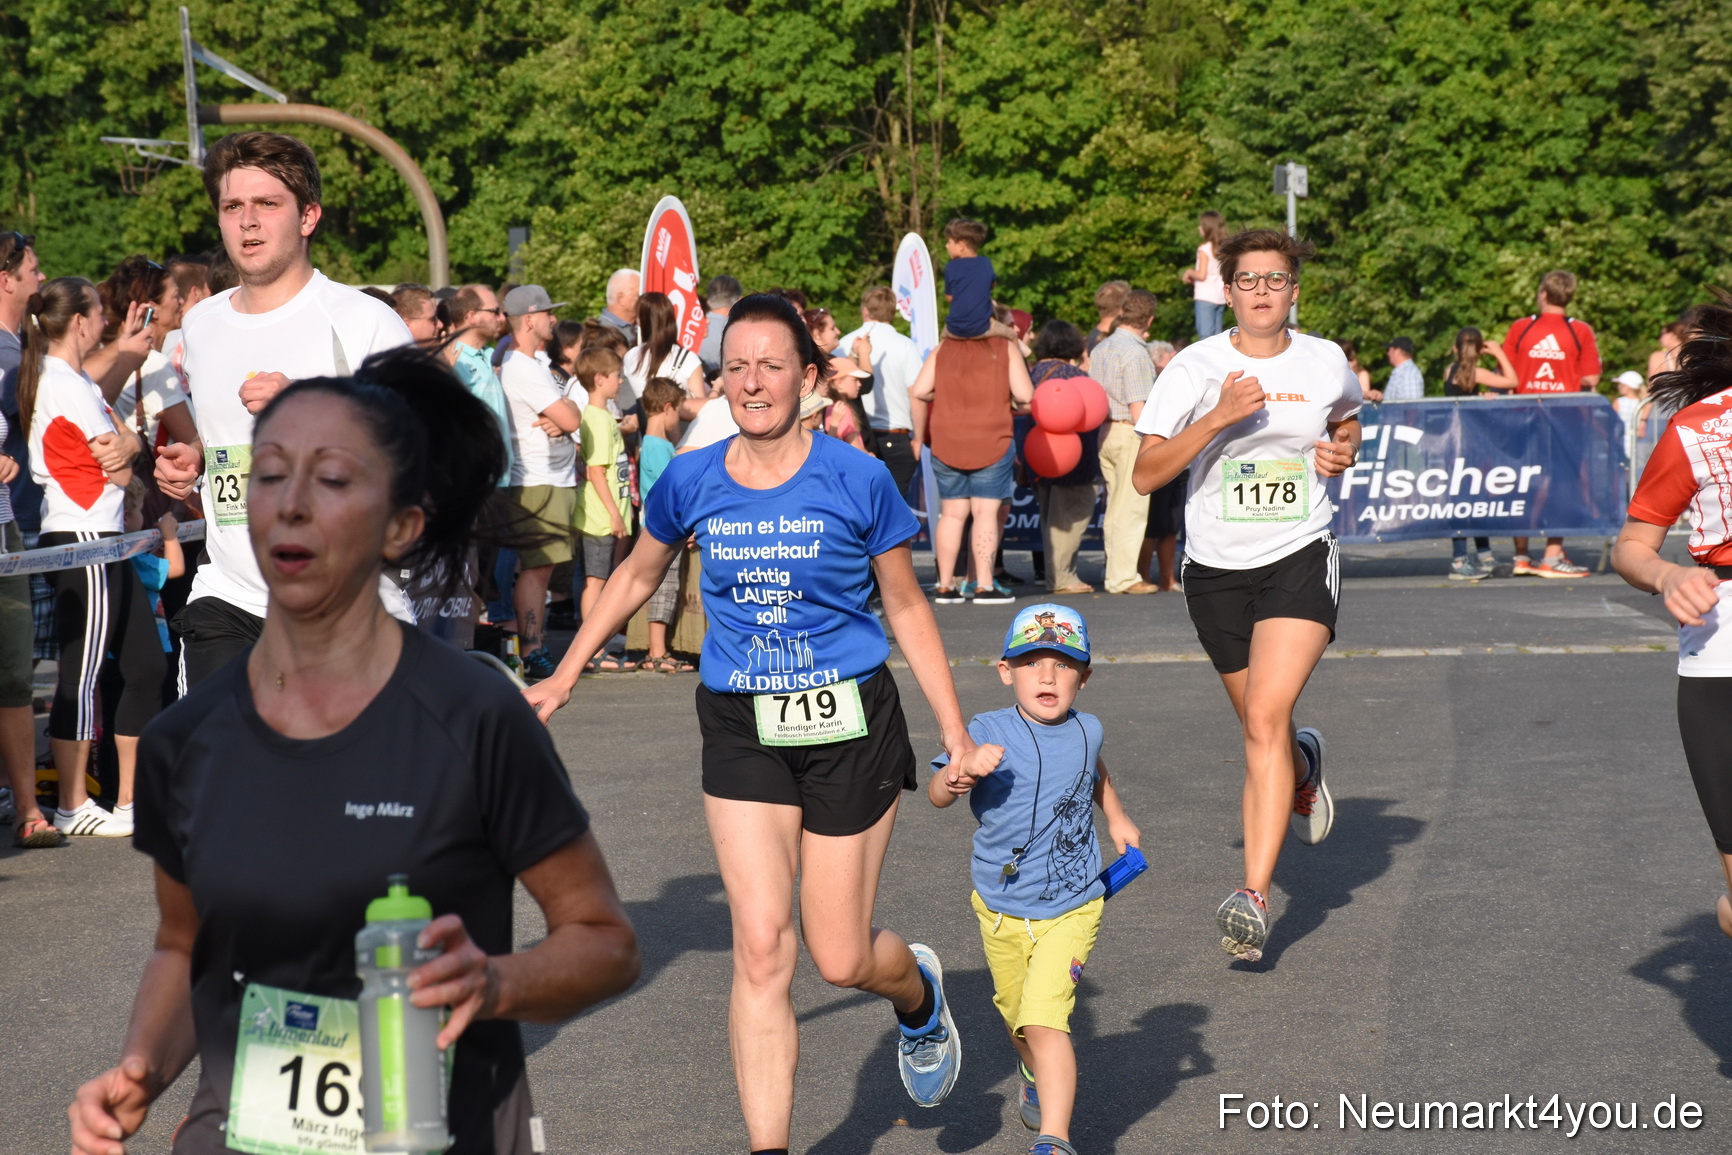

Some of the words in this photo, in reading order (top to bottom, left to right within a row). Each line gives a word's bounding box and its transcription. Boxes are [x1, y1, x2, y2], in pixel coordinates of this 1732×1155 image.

[1528, 349, 1566, 360] adidas
[1526, 381, 1565, 391] AREVA
[1265, 393, 1310, 402] LEBL
[1340, 457, 1542, 500] Fischer
[1233, 481, 1297, 505] 1178
[1358, 500, 1526, 522] AUTOMOBILE
[707, 518, 752, 536] Wenn
[757, 521, 774, 534] es
[779, 516, 824, 533] beim
[710, 540, 820, 560] Hausverkauf
[737, 567, 790, 586] richtig
[732, 587, 803, 605] LAUFEN
[756, 608, 787, 625] soll!
[728, 669, 839, 690] FELDBUSCH
[773, 690, 837, 723] 719
[777, 724, 817, 732] Blendiger
[819, 720, 843, 729] Karin
[345, 801, 375, 819] Inge
[377, 801, 414, 817] März
[280, 1055, 363, 1118] 16
[291, 1117, 328, 1134] März
